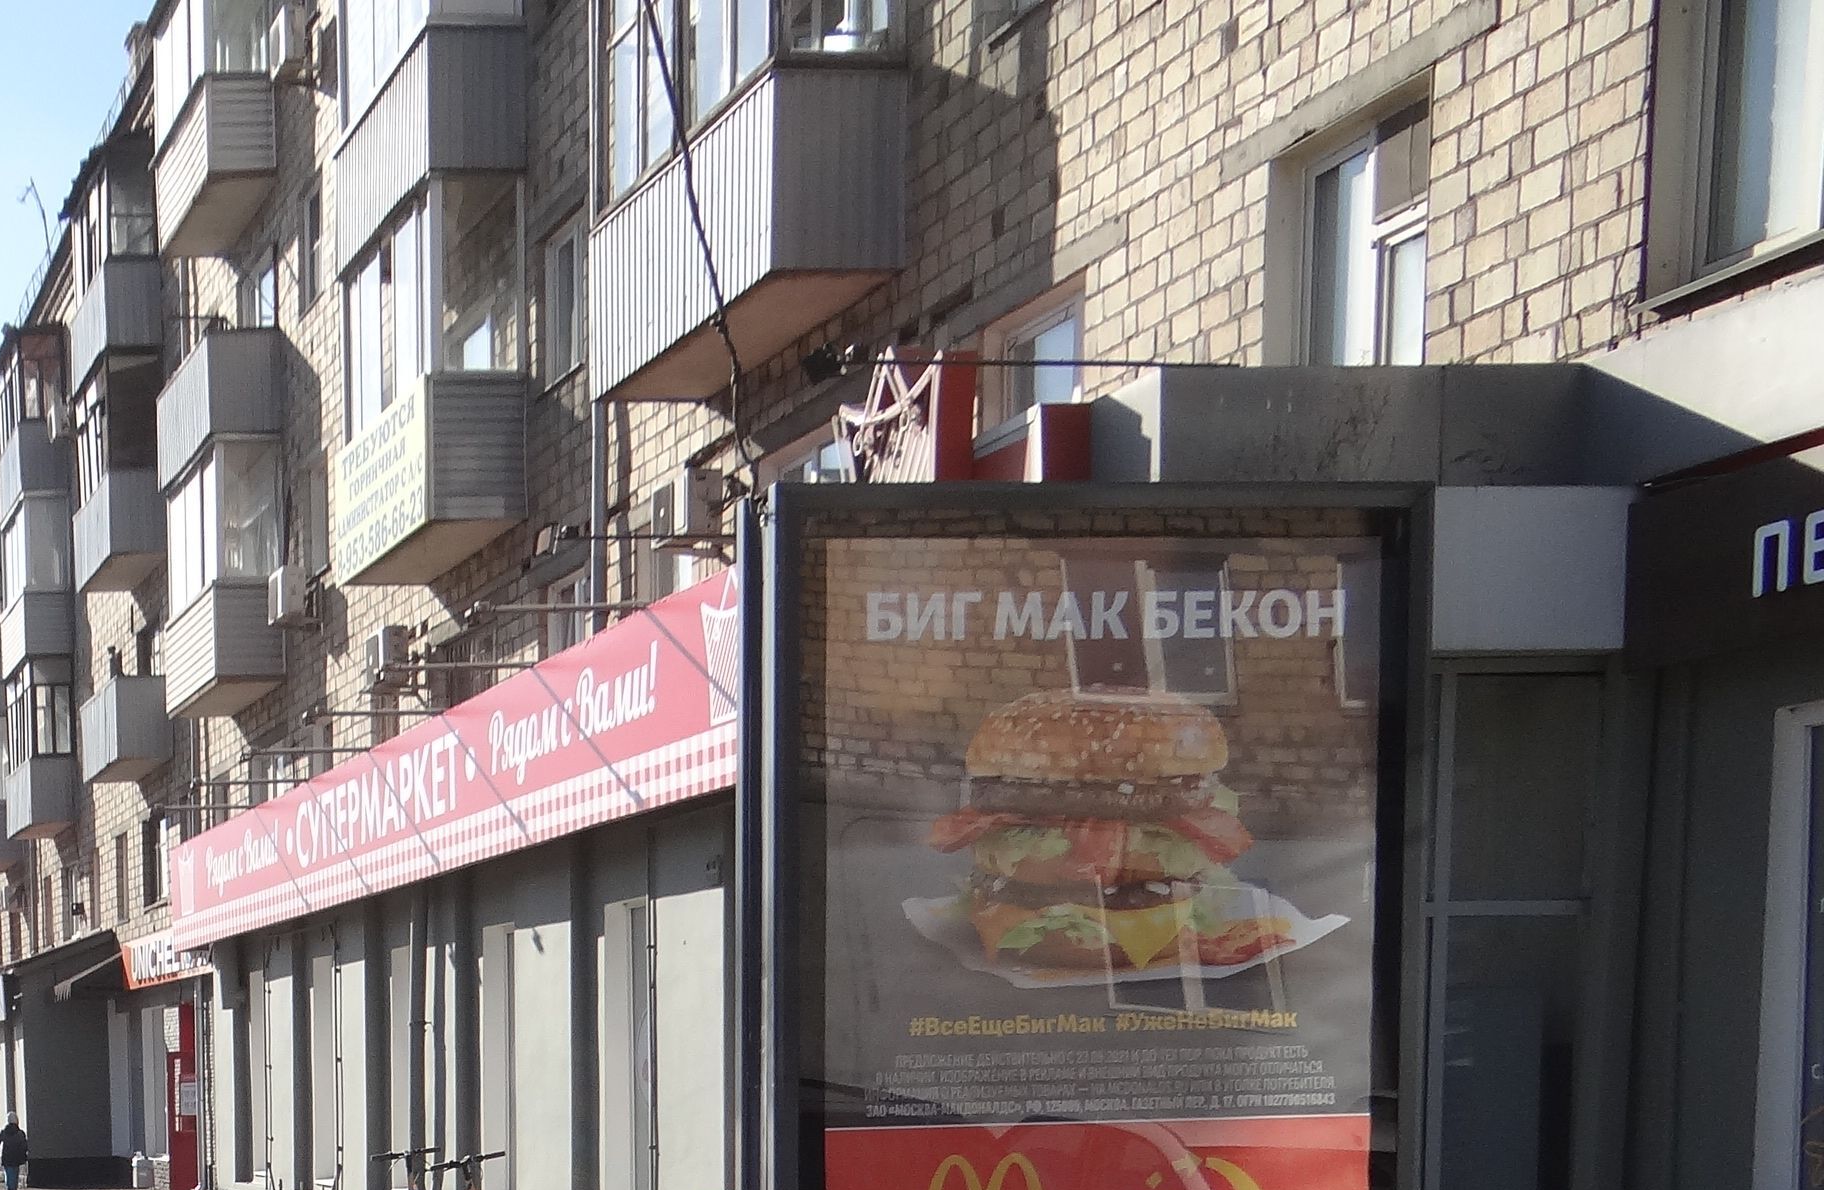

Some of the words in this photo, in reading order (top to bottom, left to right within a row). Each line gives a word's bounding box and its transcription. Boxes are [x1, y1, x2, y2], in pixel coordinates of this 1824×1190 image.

[342, 394, 415, 480] ТРЕБУЮТСЯ
[349, 436, 406, 501] ГОРНИЧНАЯ
[338, 474, 400, 539] АДМИНИСТРАТОР
[338, 485, 423, 581] 8-953-586-66-23
[866, 591, 982, 641] БИГ
[993, 591, 1128, 640] МАК
[1142, 588, 1347, 638] БЕКОН
[206, 846, 237, 898] Рядом
[237, 846, 244, 877] с
[244, 818, 279, 874] Вами!
[296, 730, 459, 868] СУПЕРМАРКЕТ
[489, 710, 558, 785] Рядом
[561, 698, 573, 747] с
[576, 640, 658, 741] Вами!
[131, 935, 179, 982] UNICHEL
[909, 1015, 1106, 1037] #ВсеЕщеБигМак
[1116, 1009, 1297, 1031] #УжеНеБигМак
